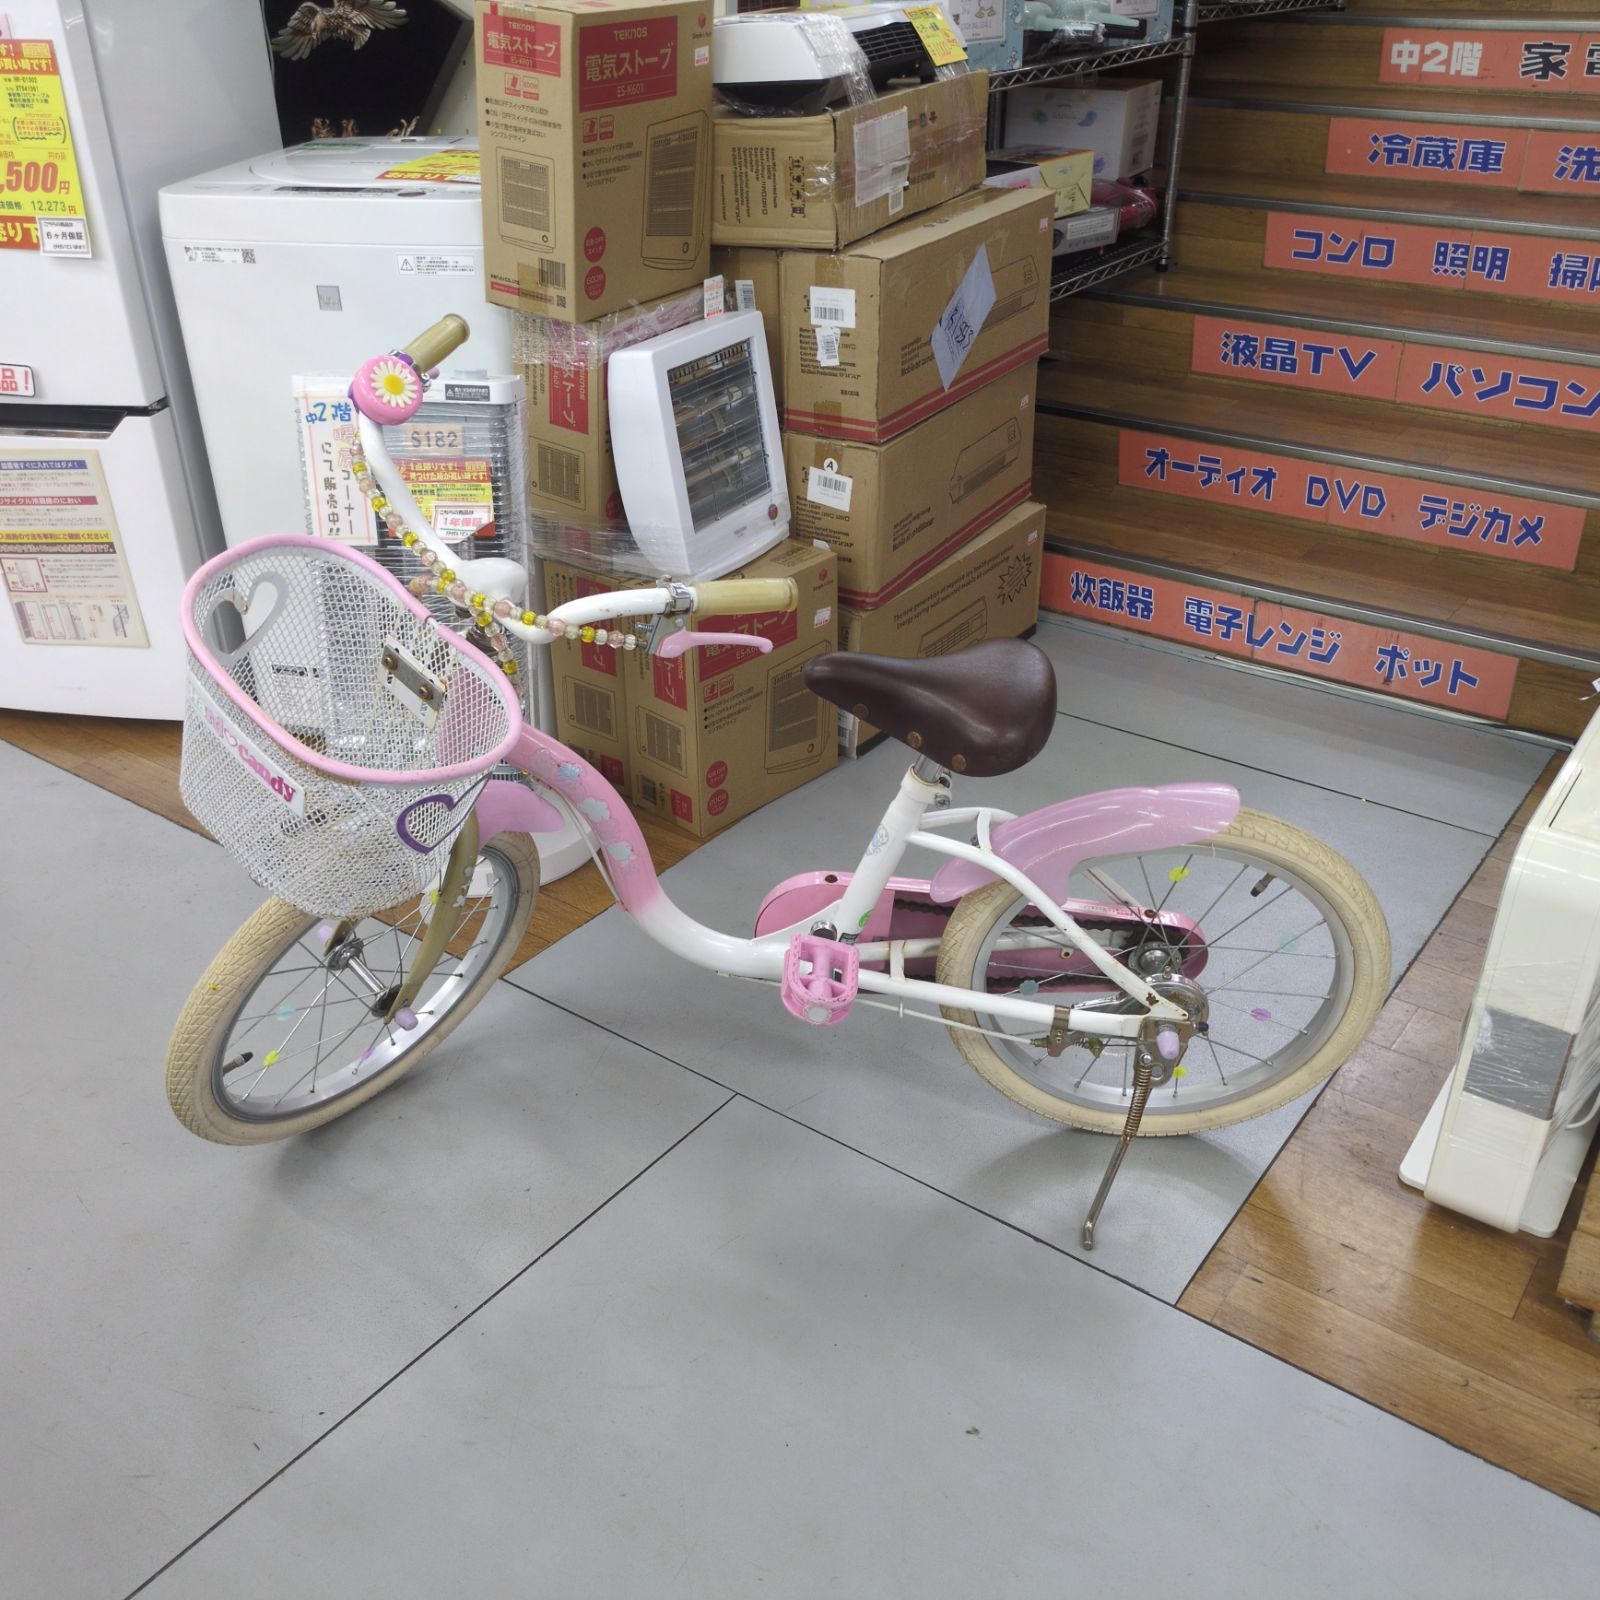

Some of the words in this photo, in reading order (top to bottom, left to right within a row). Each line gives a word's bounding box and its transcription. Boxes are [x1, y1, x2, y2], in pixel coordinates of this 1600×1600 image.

[487, 30, 559, 58] 電気ストーブ
[613, 26, 648, 41] TEKNOS
[584, 41, 675, 82] 電気ストーブ
[1390, 40, 1483, 77] 中2階
[1366, 133, 1507, 174] 冷蔵庫
[1291, 229, 1396, 269] コンロ
[1431, 240, 1511, 281] 照明
[1219, 330, 1378, 382] 液晶TV
[1419, 360, 1600, 419] パソコン
[305, 402, 352, 424] 中2階
[411, 431, 459, 448] S182
[1144, 448, 1278, 501] オーディオ
[1306, 476, 1387, 519] DVD
[1417, 493, 1546, 548] デジカメ
[1069, 571, 1155, 622] 炊飯器
[1183, 596, 1342, 664] 電子レンジ
[1374, 643, 1479, 695] ポット
